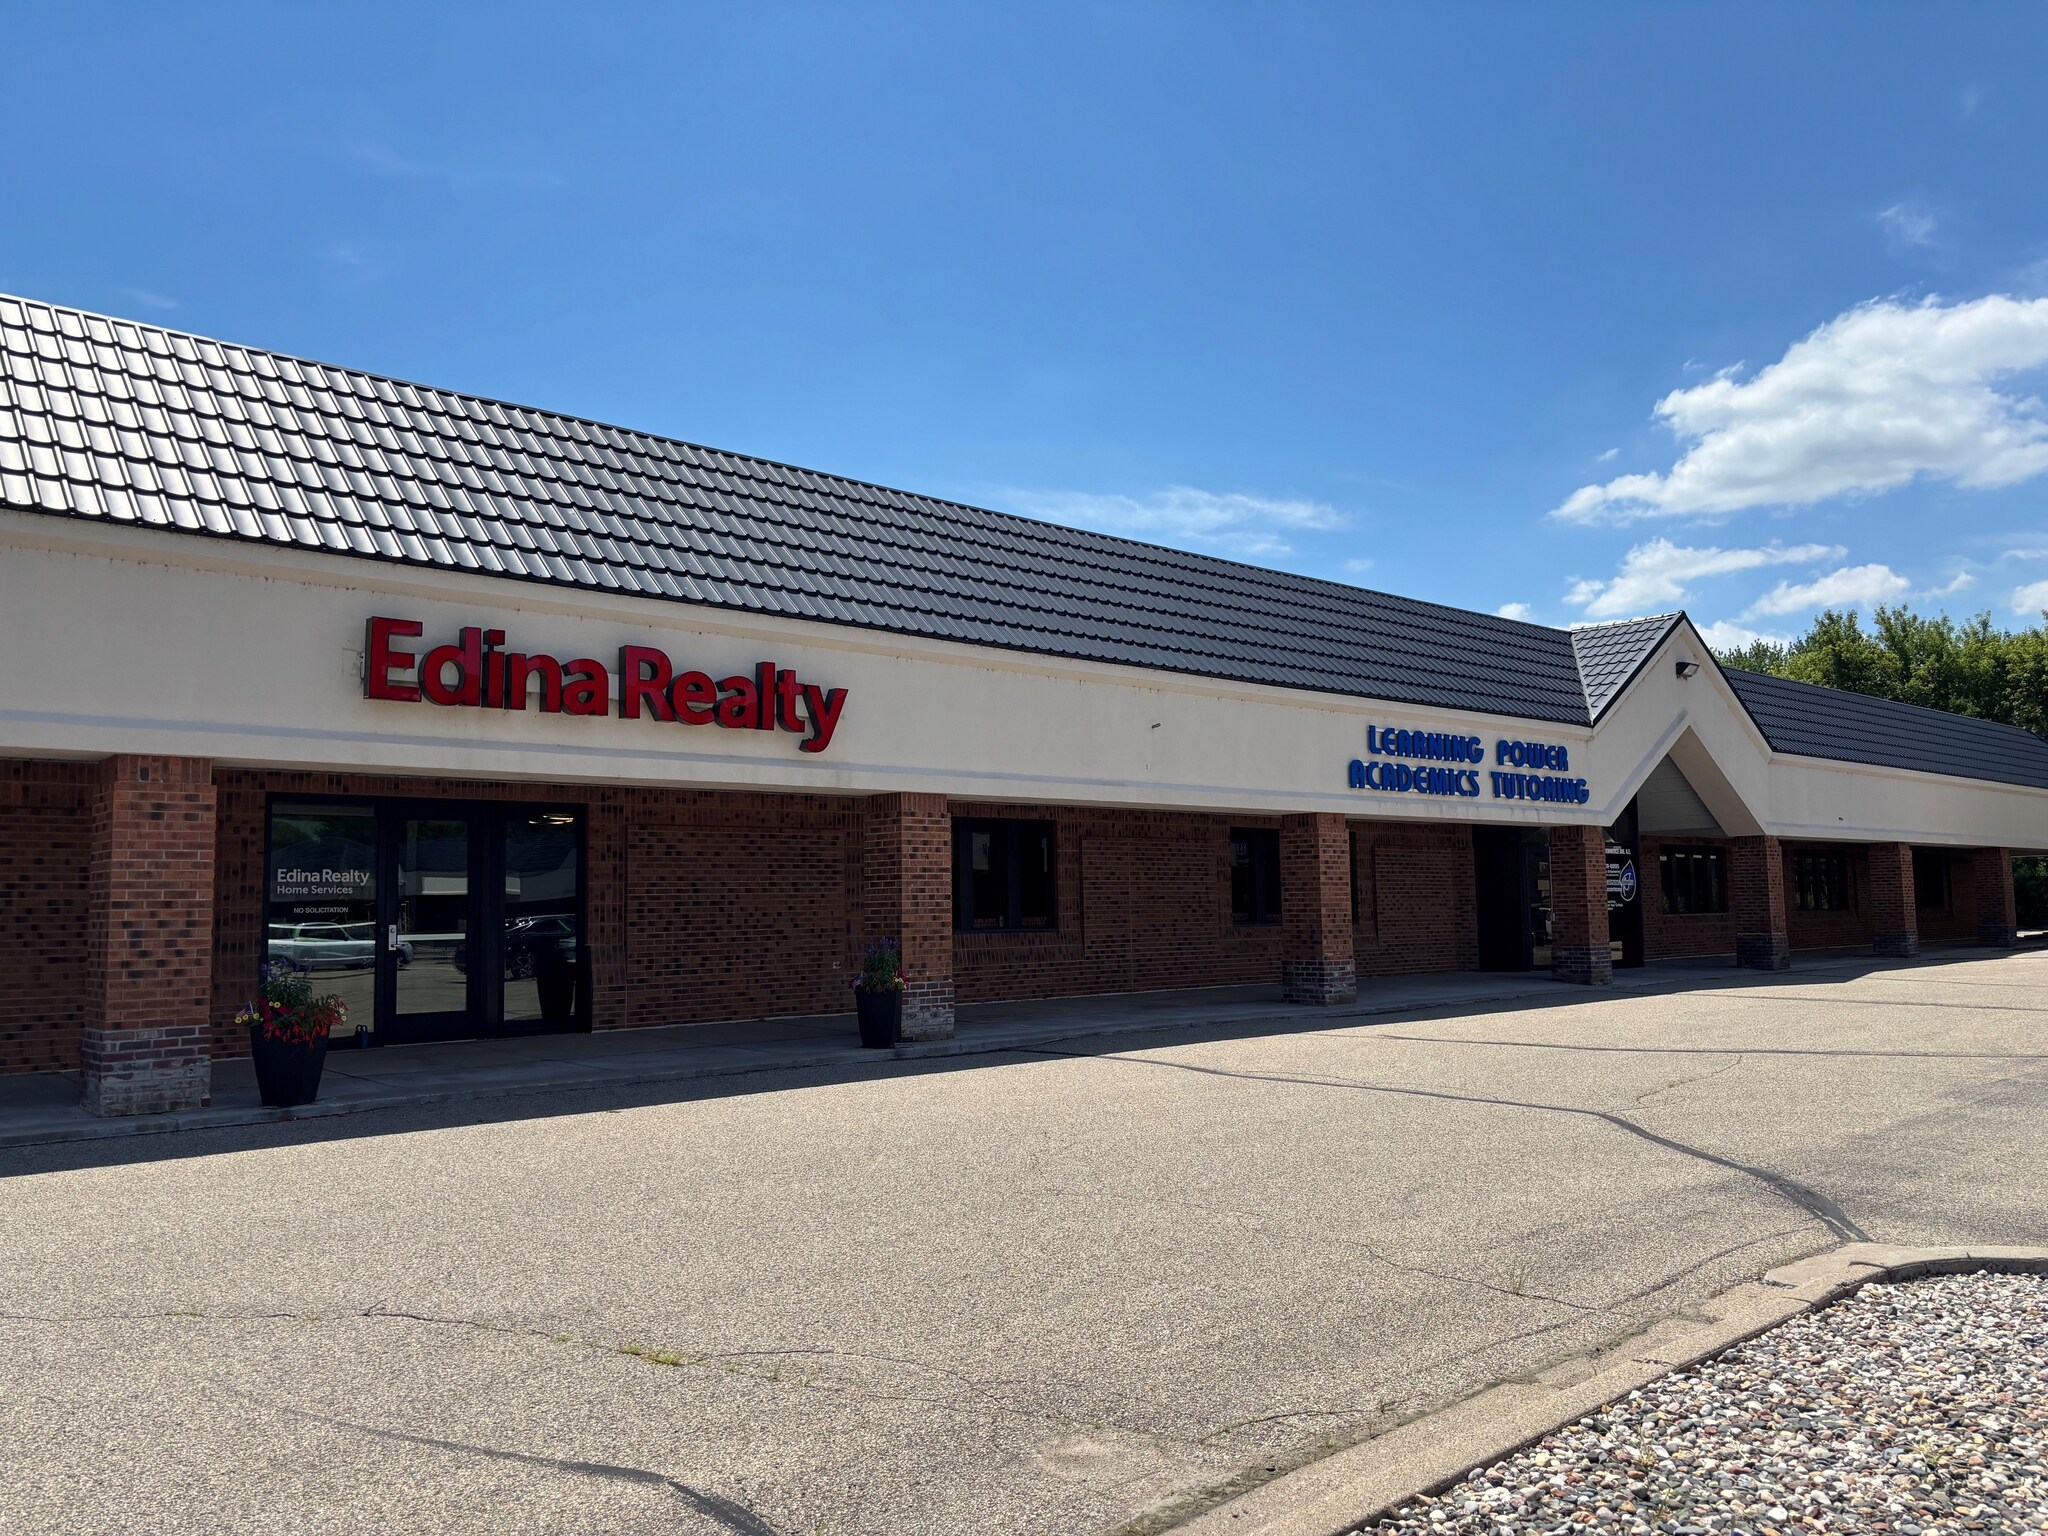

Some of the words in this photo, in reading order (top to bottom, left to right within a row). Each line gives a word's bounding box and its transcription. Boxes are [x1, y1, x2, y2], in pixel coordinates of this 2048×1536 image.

[363, 616, 609, 717] Edina
[618, 645, 849, 753] Realty
[1368, 725, 1484, 764] LEARNING
[1497, 740, 1569, 771] POWER
[1348, 759, 1480, 797] ACADEMICS
[1490, 771, 1590, 804] TUTORING
[277, 868, 320, 882] Edina
[322, 868, 370, 885] Realty
[277, 885, 309, 894] Home
[311, 885, 353, 894] Services
